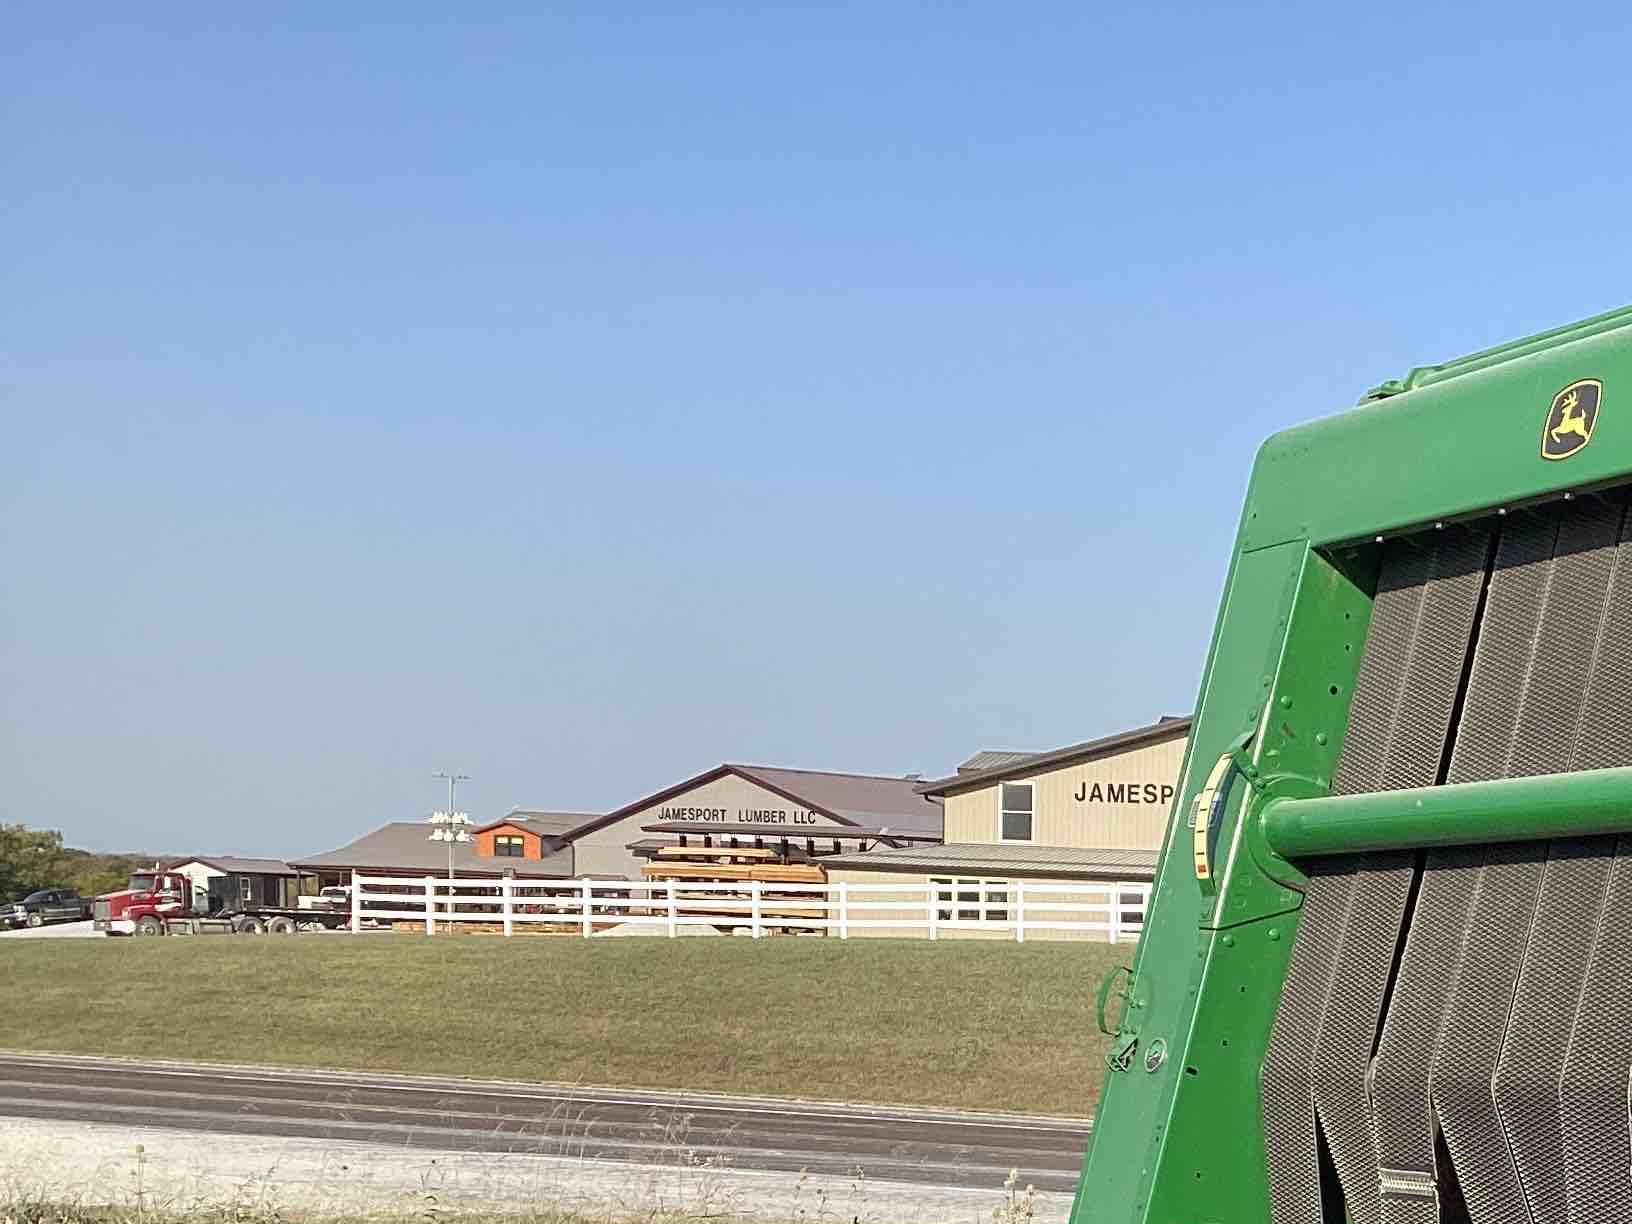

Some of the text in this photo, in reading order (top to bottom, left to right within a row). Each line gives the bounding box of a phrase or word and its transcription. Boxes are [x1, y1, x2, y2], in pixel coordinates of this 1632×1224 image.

[658, 807, 816, 824] JAMESPORT LUMBER LLC
